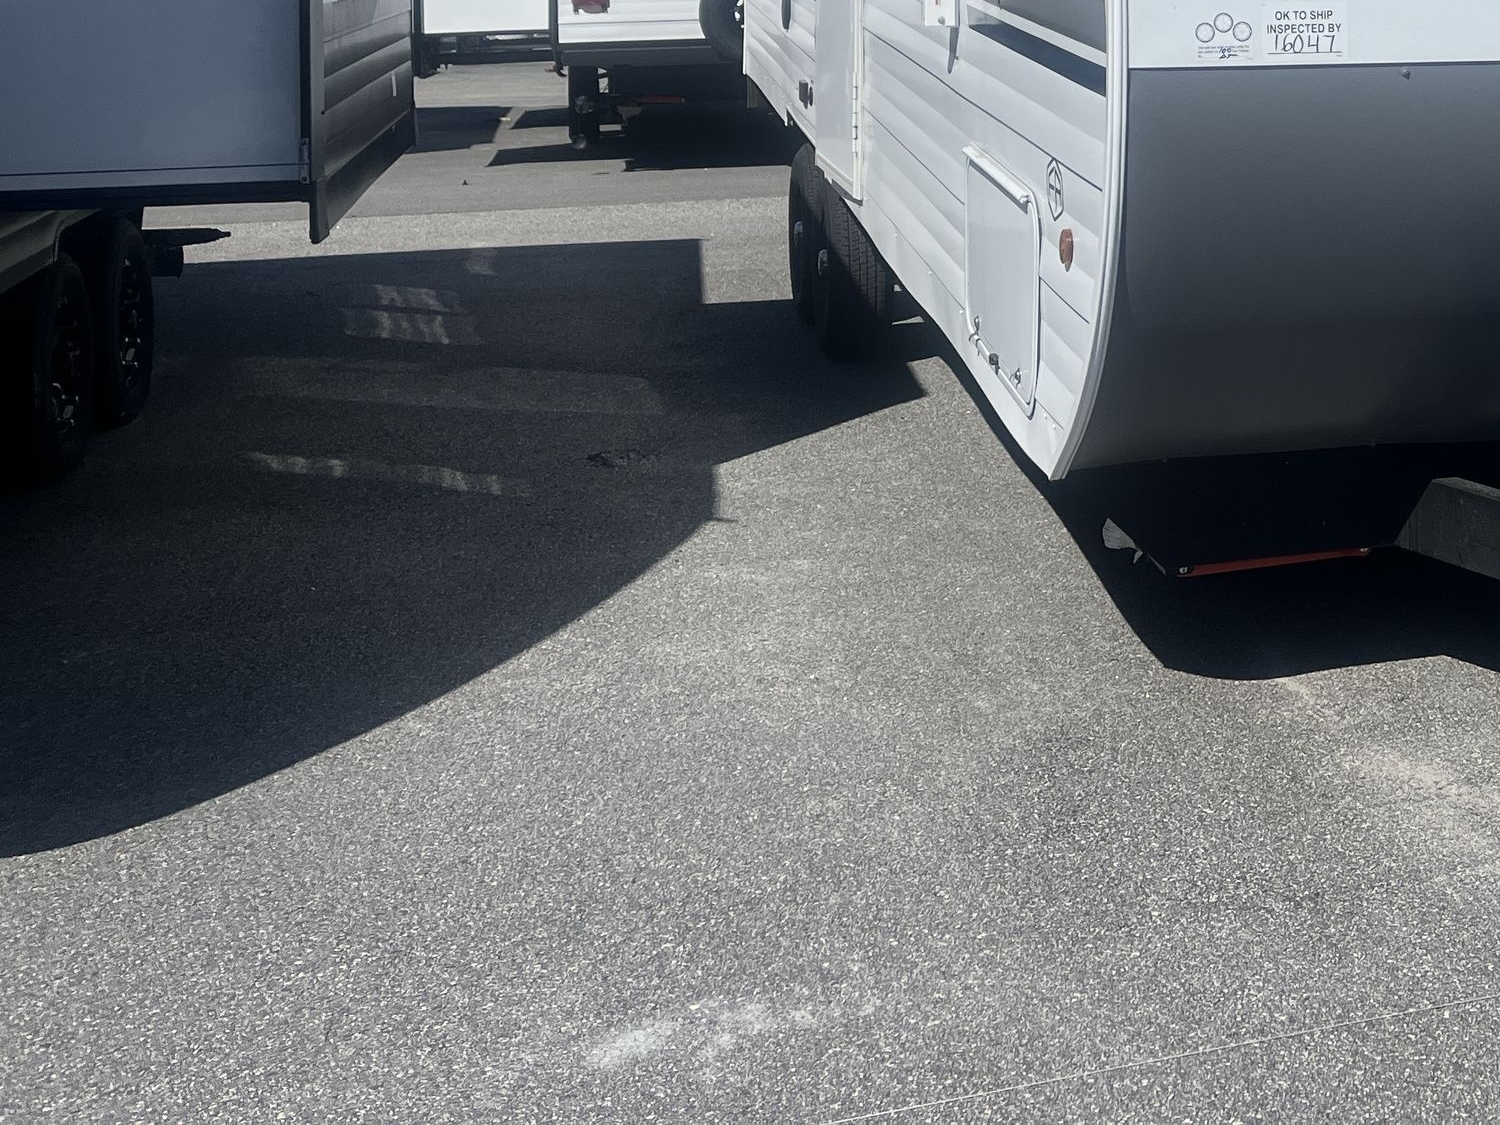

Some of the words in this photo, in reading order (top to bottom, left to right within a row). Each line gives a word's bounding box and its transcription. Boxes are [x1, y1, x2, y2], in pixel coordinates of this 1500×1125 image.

[1274, 10, 1291, 21] OK
[1293, 10, 1307, 20] TO
[1309, 10, 1334, 20] SHIP
[1266, 23, 1325, 35] INSPECTED
[1328, 23, 1342, 33] BY
[1274, 33, 1336, 54] 16047
